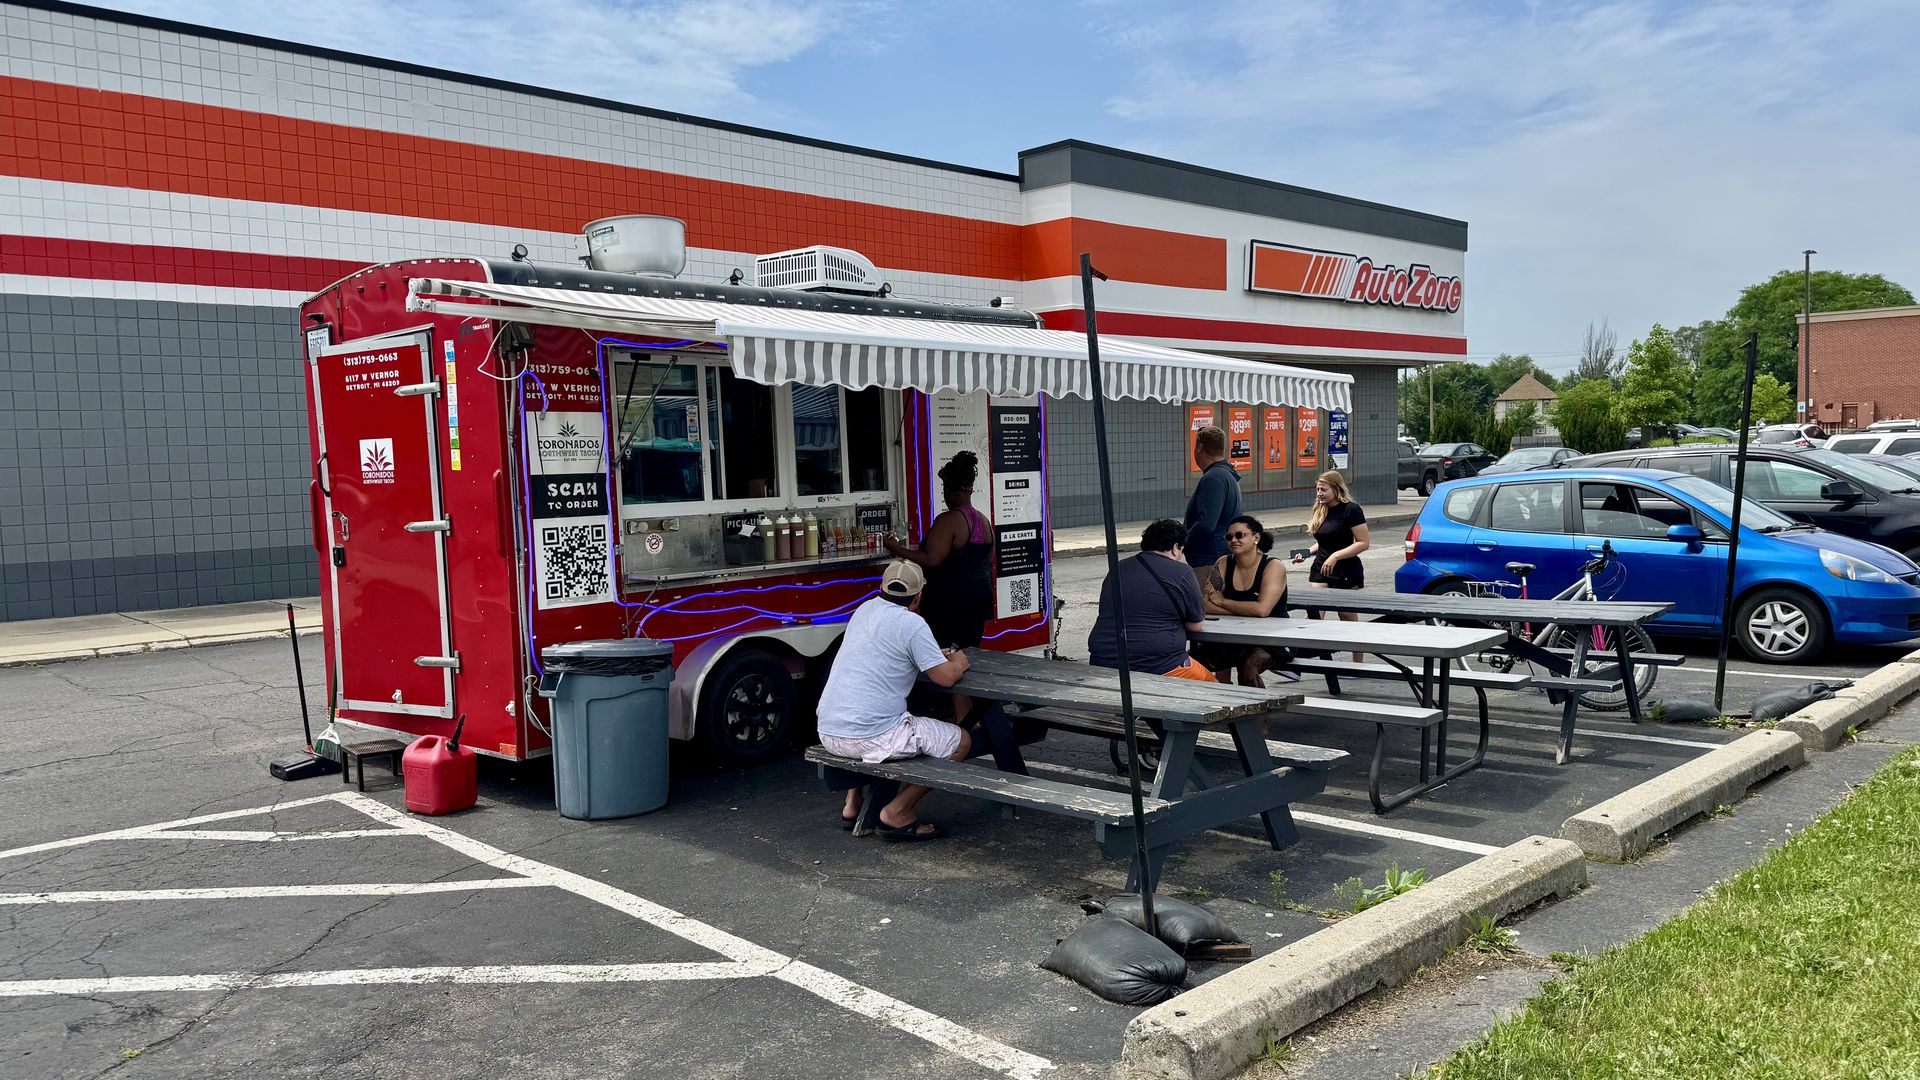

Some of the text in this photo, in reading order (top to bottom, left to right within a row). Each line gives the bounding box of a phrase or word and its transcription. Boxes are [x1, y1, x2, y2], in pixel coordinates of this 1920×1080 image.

[1349, 257, 1463, 313] AutoZone
[343, 352, 398, 366] (313)759-0663
[362, 373, 368, 381] W
[370, 370, 399, 380] VERNOR
[550, 383, 559, 391] W
[1265, 421, 1270, 430] 2
[1269, 421, 1279, 430] FOR
[538, 439, 600, 450] CORONADOS
[547, 482, 598, 497] SCAN
[547, 500, 599, 510] TO ORDER
[861, 510, 887, 518] ORDER
